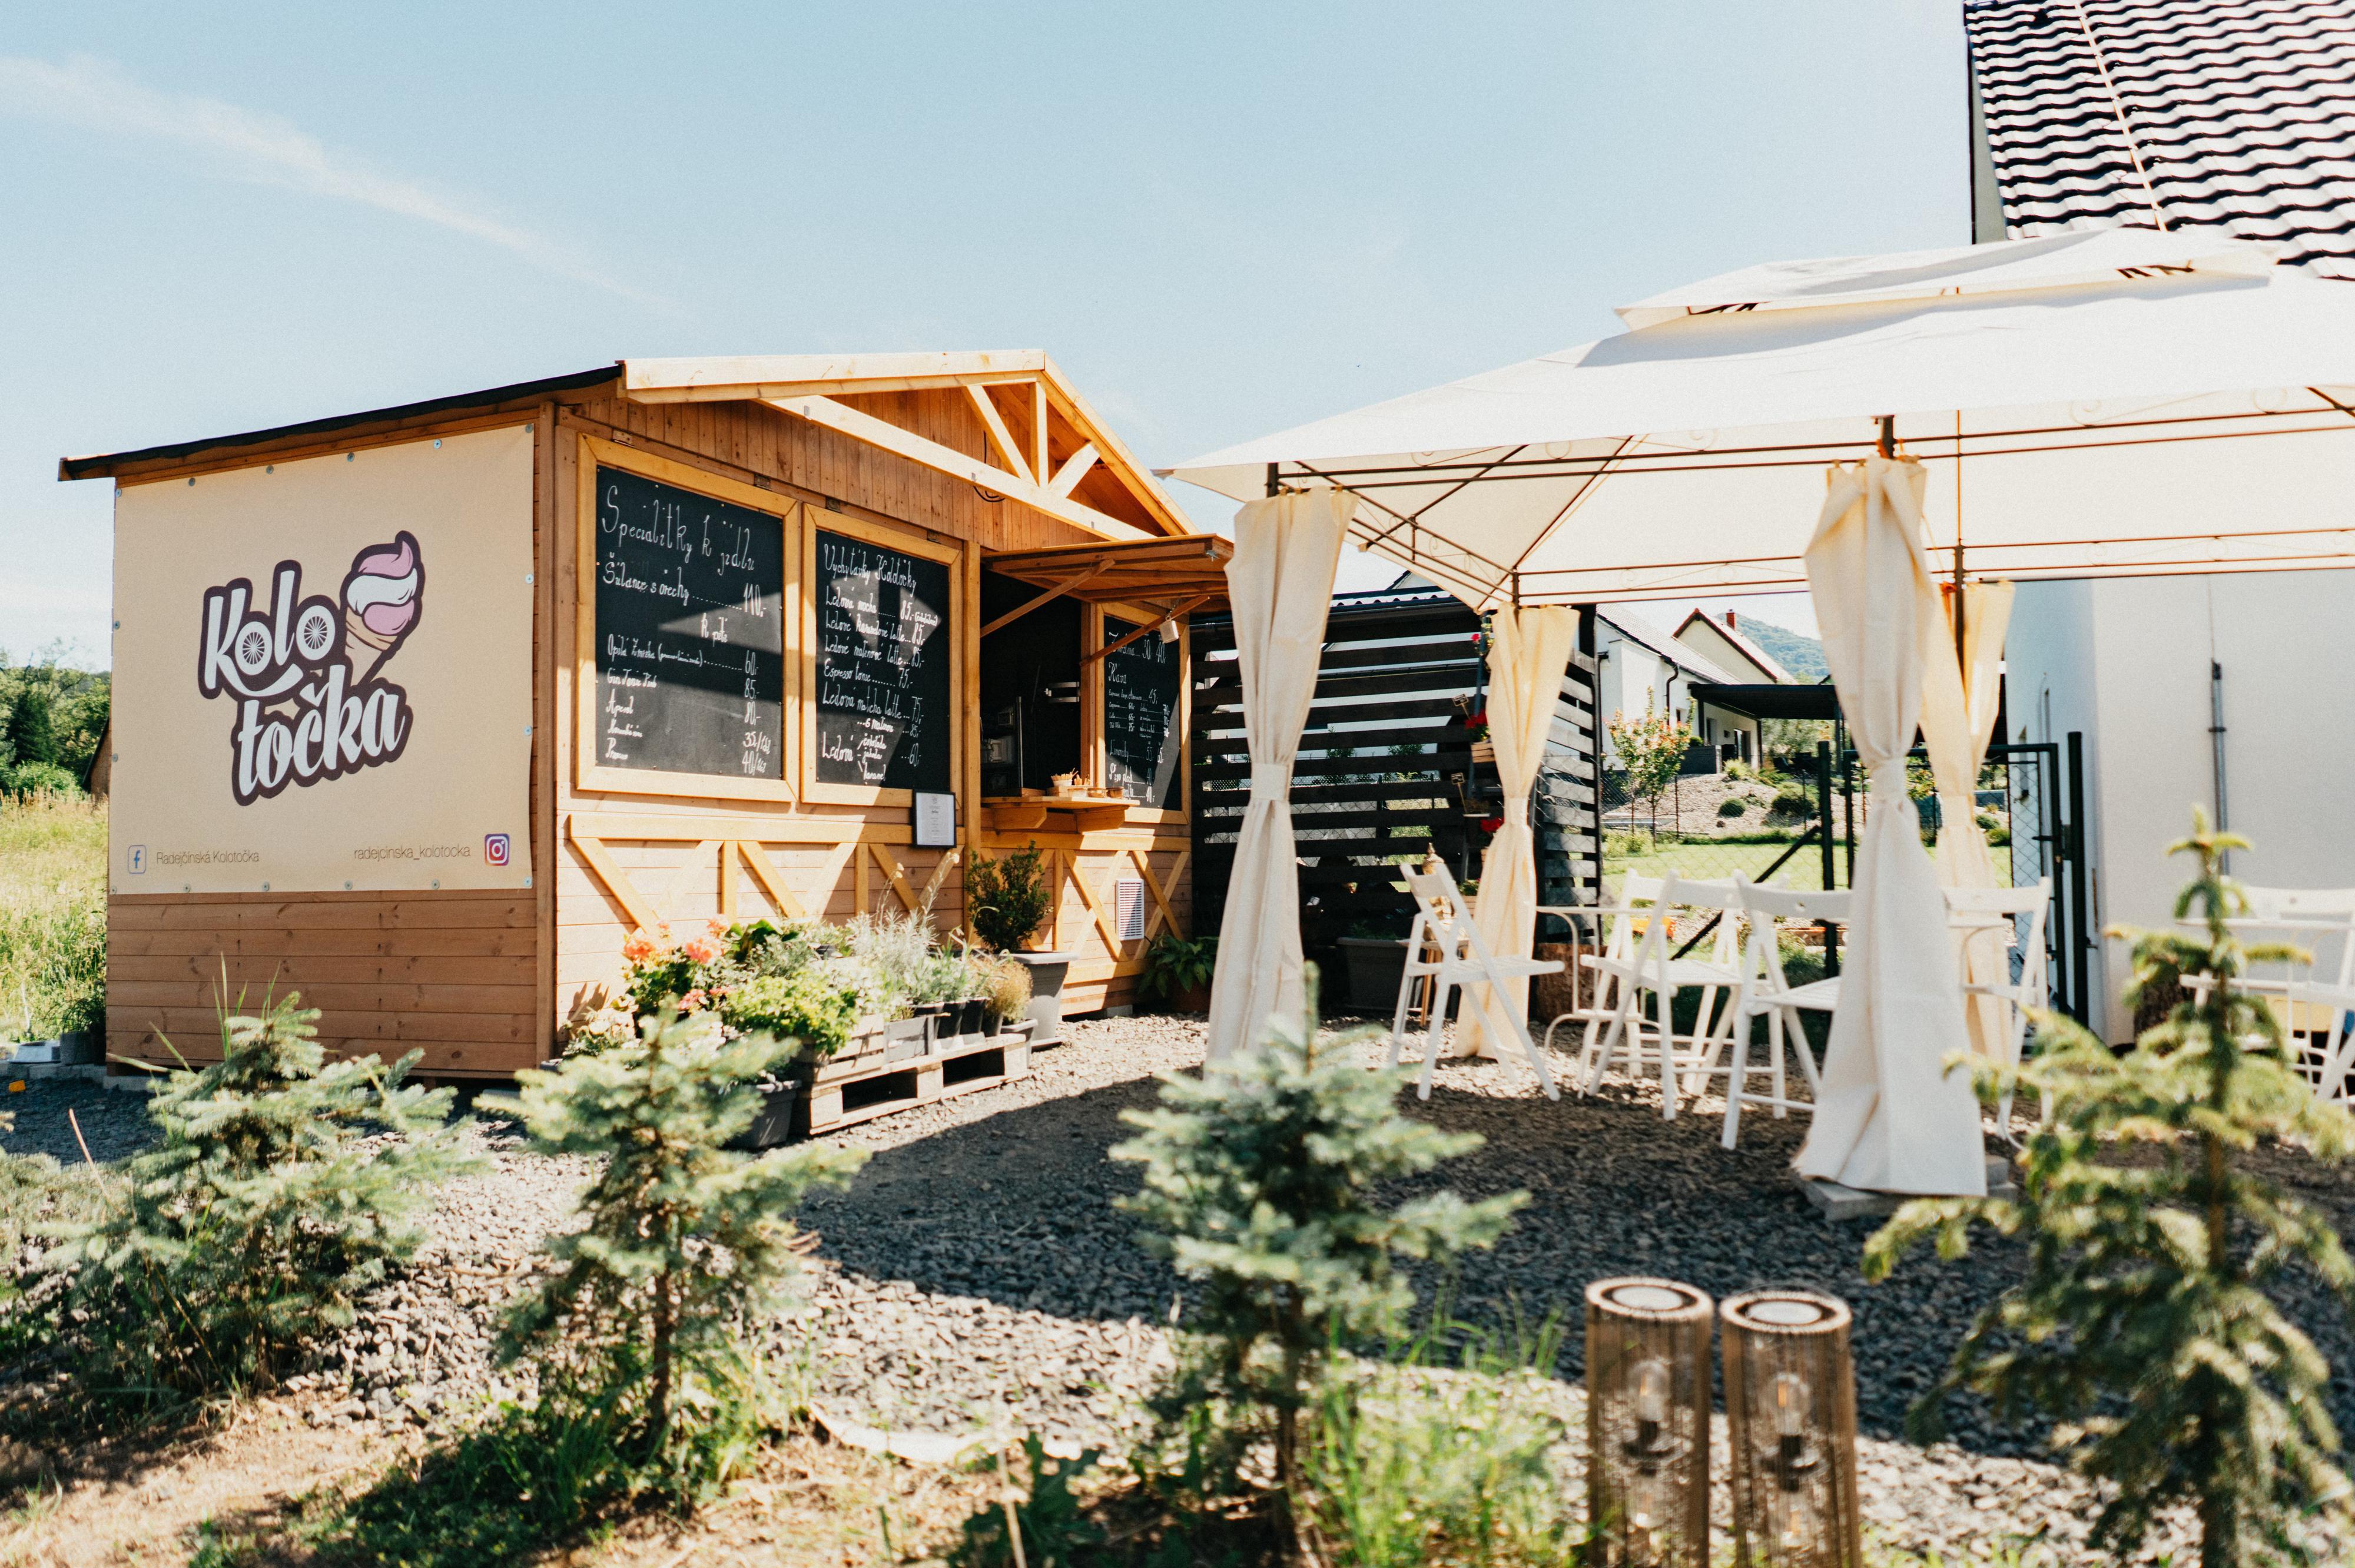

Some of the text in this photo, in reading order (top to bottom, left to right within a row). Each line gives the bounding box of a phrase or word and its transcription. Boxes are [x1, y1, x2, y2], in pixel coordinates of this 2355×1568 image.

[702, 514, 712, 556] k
[650, 582, 656, 593] s
[201, 565, 337, 698] Kolo
[236, 662, 409, 799] točka
[157, 849, 260, 867] Radejčínská Kolotočka
[353, 843, 471, 862] radejcinska_kolotocka
